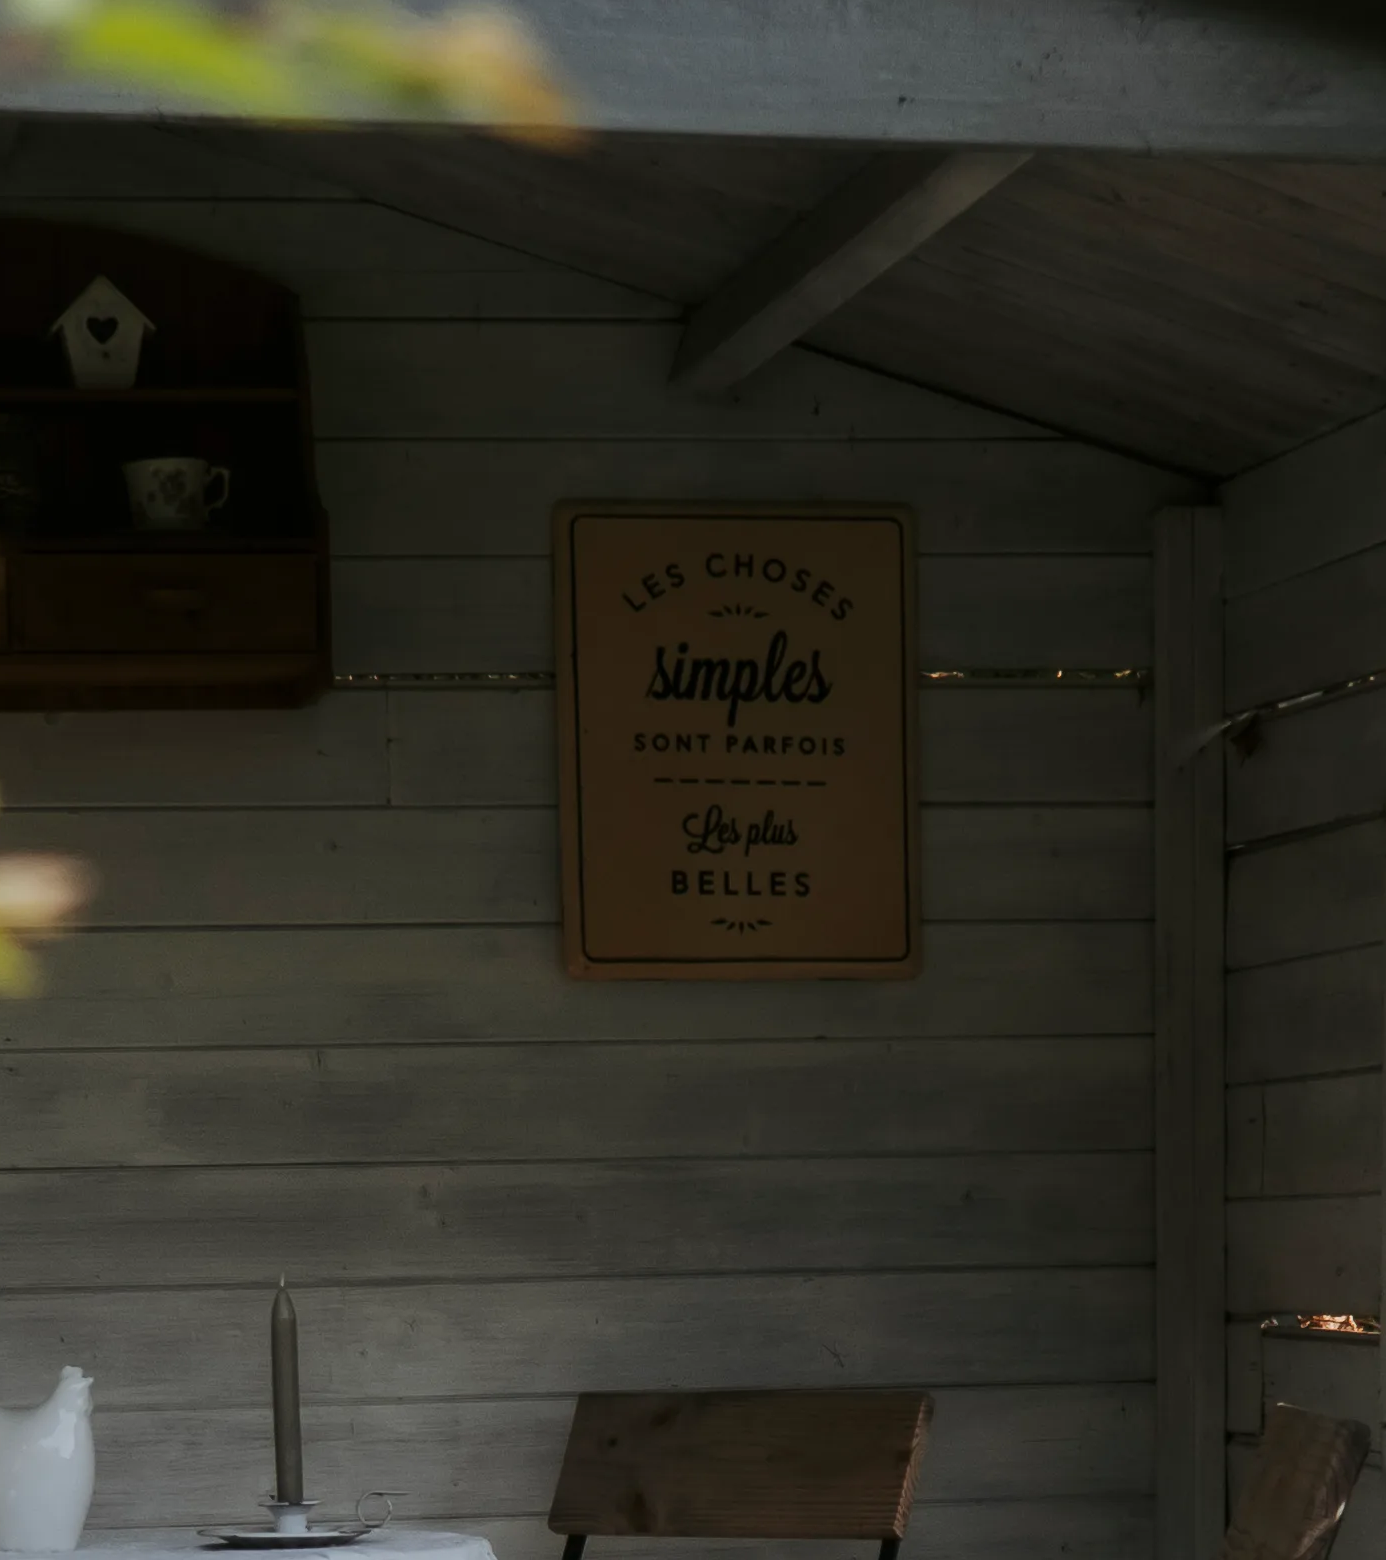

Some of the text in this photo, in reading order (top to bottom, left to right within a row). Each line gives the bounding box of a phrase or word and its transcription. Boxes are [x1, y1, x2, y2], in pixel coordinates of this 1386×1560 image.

[622, 552, 854, 621] LES CHOSES
[645, 630, 832, 727] simples
[633, 733, 846, 756] SONT PARFOIS
[682, 804, 799, 857] Les plus
[671, 870, 812, 897] BELLES
